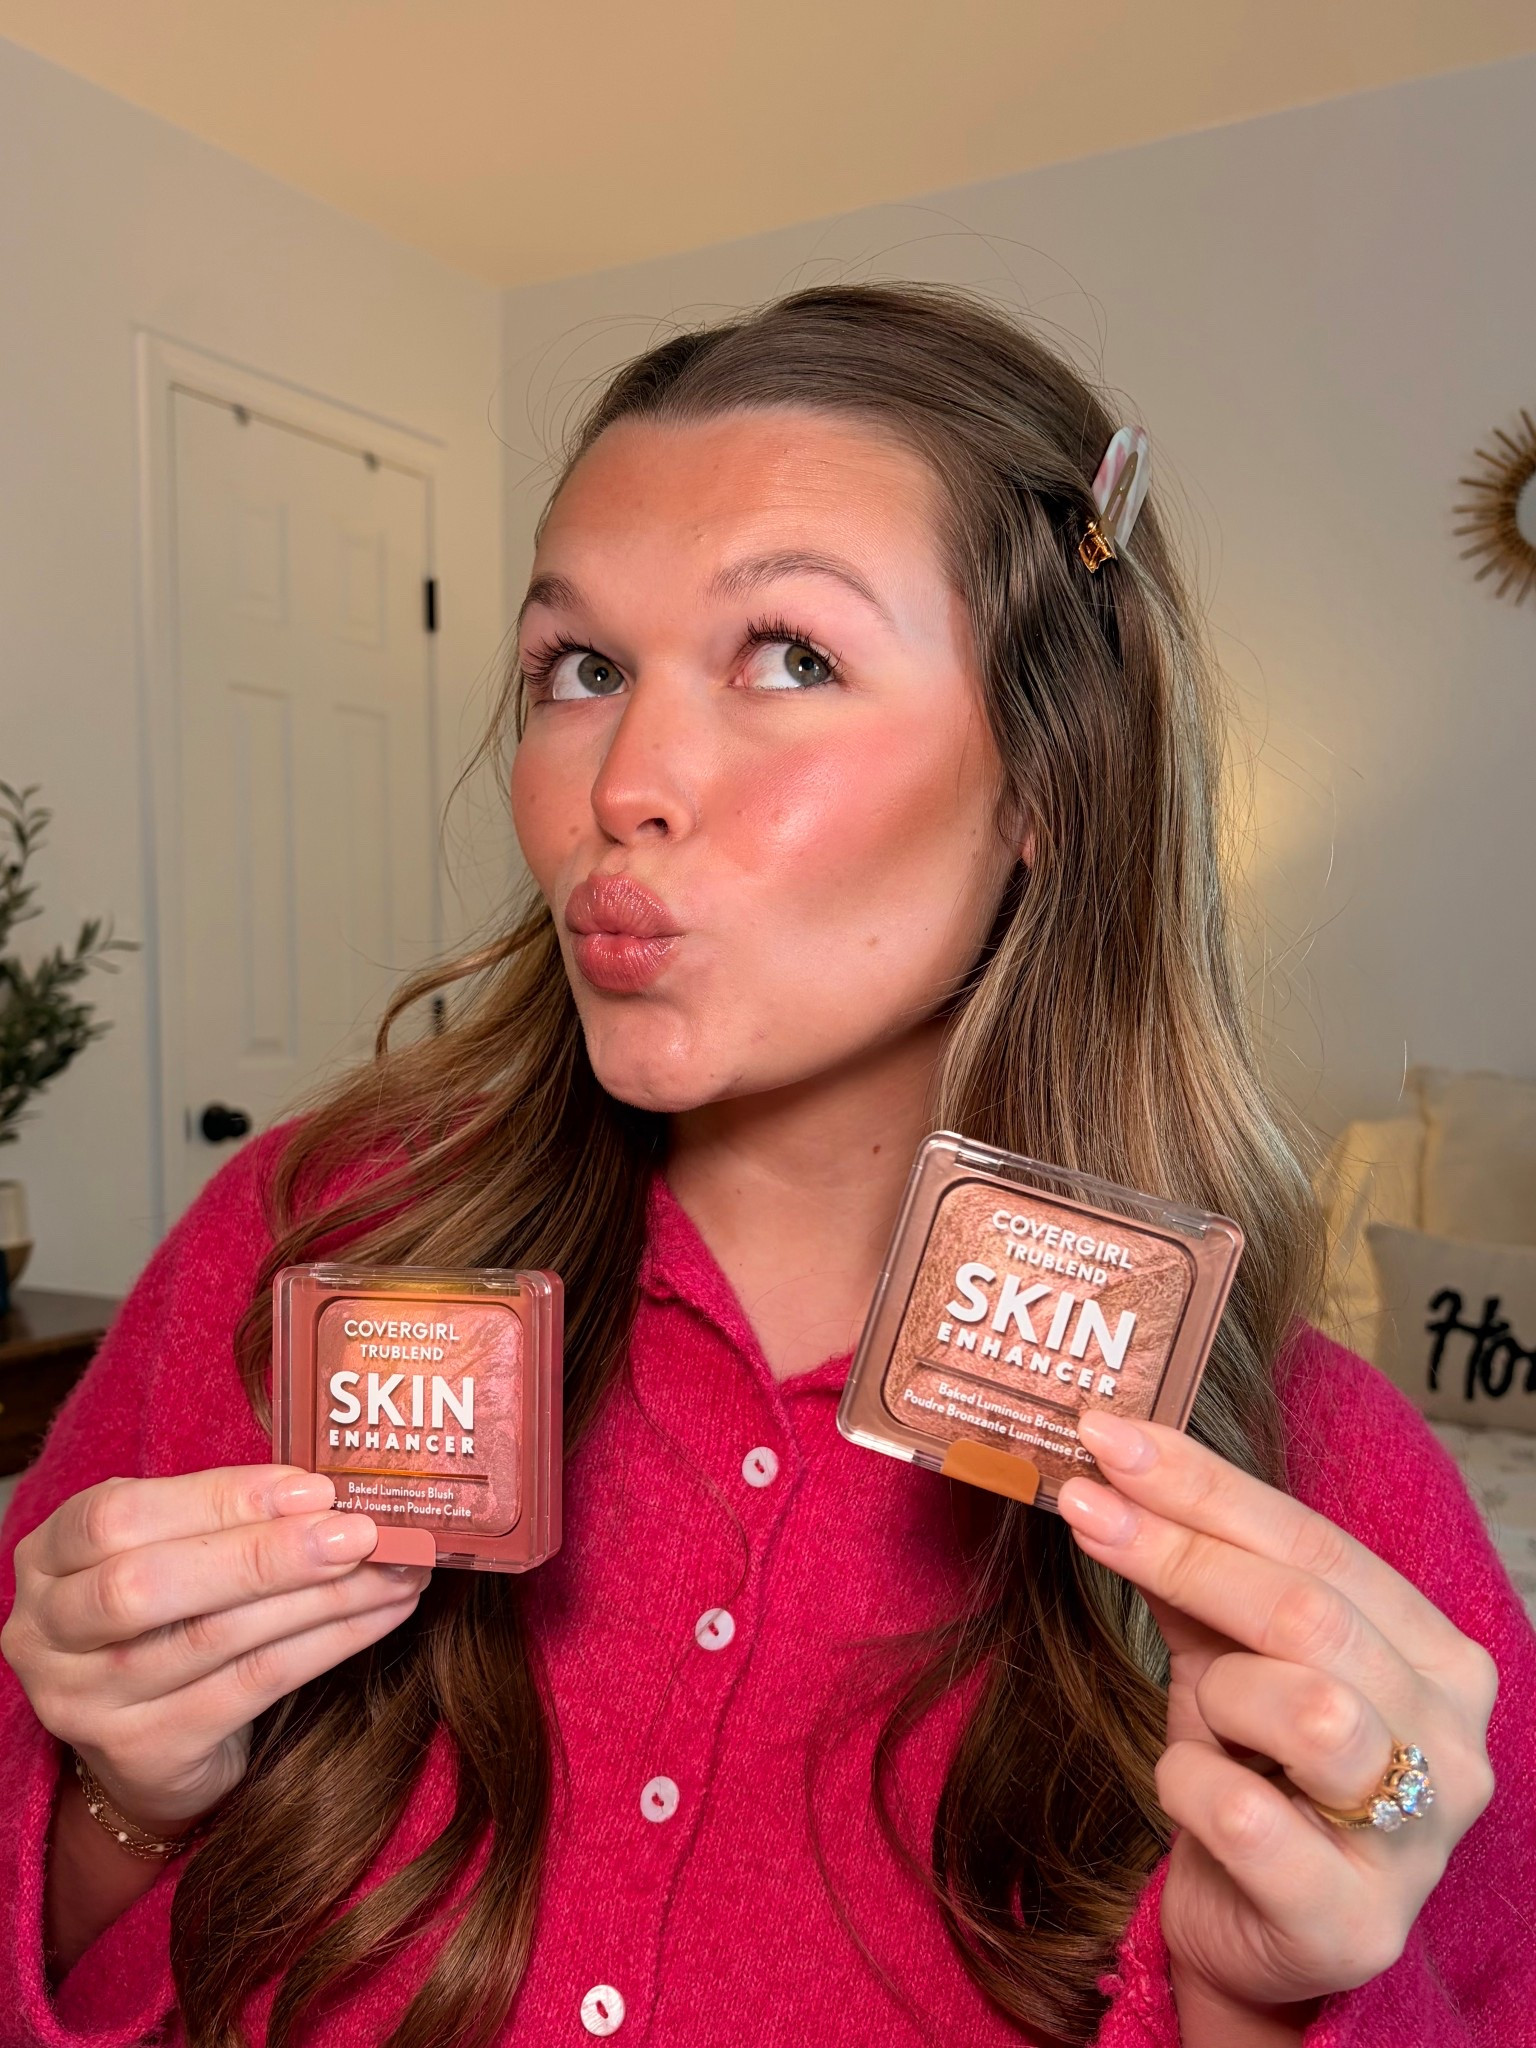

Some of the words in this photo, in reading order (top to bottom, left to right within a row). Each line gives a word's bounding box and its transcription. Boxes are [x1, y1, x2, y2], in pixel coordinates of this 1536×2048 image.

[992, 1210, 1134, 1270] COVERGIRL
[1005, 1240, 1107, 1286] TRUBLEND
[344, 1320, 460, 1341] COVERGIRL
[945, 1262, 1137, 1371] SKIN
[360, 1344, 444, 1361] TRUBLEND
[936, 1321, 1117, 1397] ENHANCER
[329, 1371, 474, 1430] SKIN
[903, 1389, 945, 1413] Poudre
[946, 1403, 1007, 1434] Bronzante
[1008, 1426, 1072, 1456] Lumineuse
[938, 1382, 976, 1405] Baked
[976, 1395, 1033, 1424] Luminous
[329, 1430, 475, 1454] ENHANCER
[348, 1482, 378, 1495] Baked
[380, 1484, 426, 1498] Luminous
[427, 1487, 454, 1500] Blush
[354, 1496, 363, 1509] À
[364, 1499, 391, 1512] Joues
[393, 1504, 405, 1513] en
[407, 1502, 442, 1515] Poudre
[443, 1504, 472, 1517] Cuite
